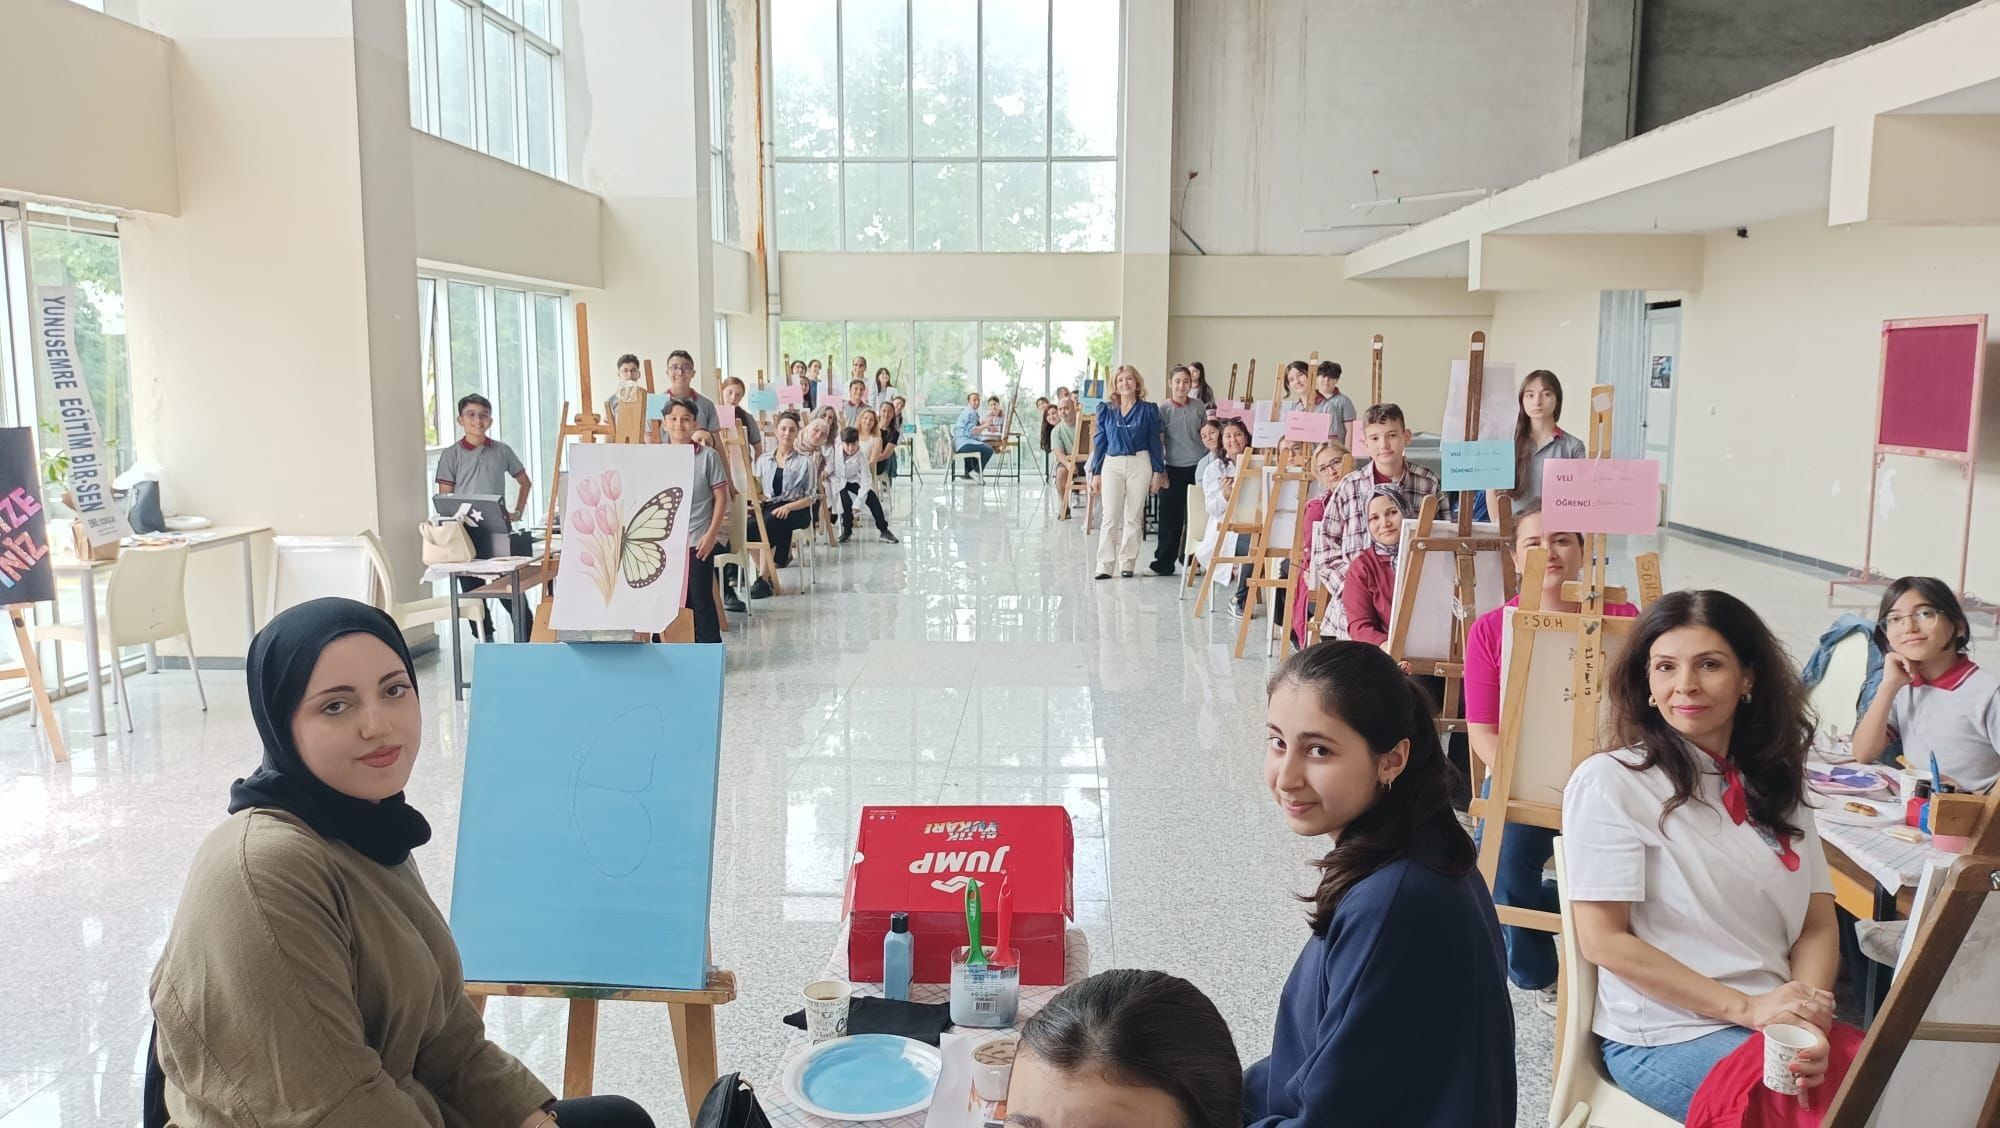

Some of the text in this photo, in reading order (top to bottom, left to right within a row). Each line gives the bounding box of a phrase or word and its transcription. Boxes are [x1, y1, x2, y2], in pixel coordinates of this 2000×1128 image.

[43, 296, 78, 390] YUNUSEMRE
[59, 398, 96, 450] EĞİTİM
[1556, 474, 1573, 482] VELİ
[924, 821, 998, 834] YUKARI
[909, 846, 1010, 873] JUMP
